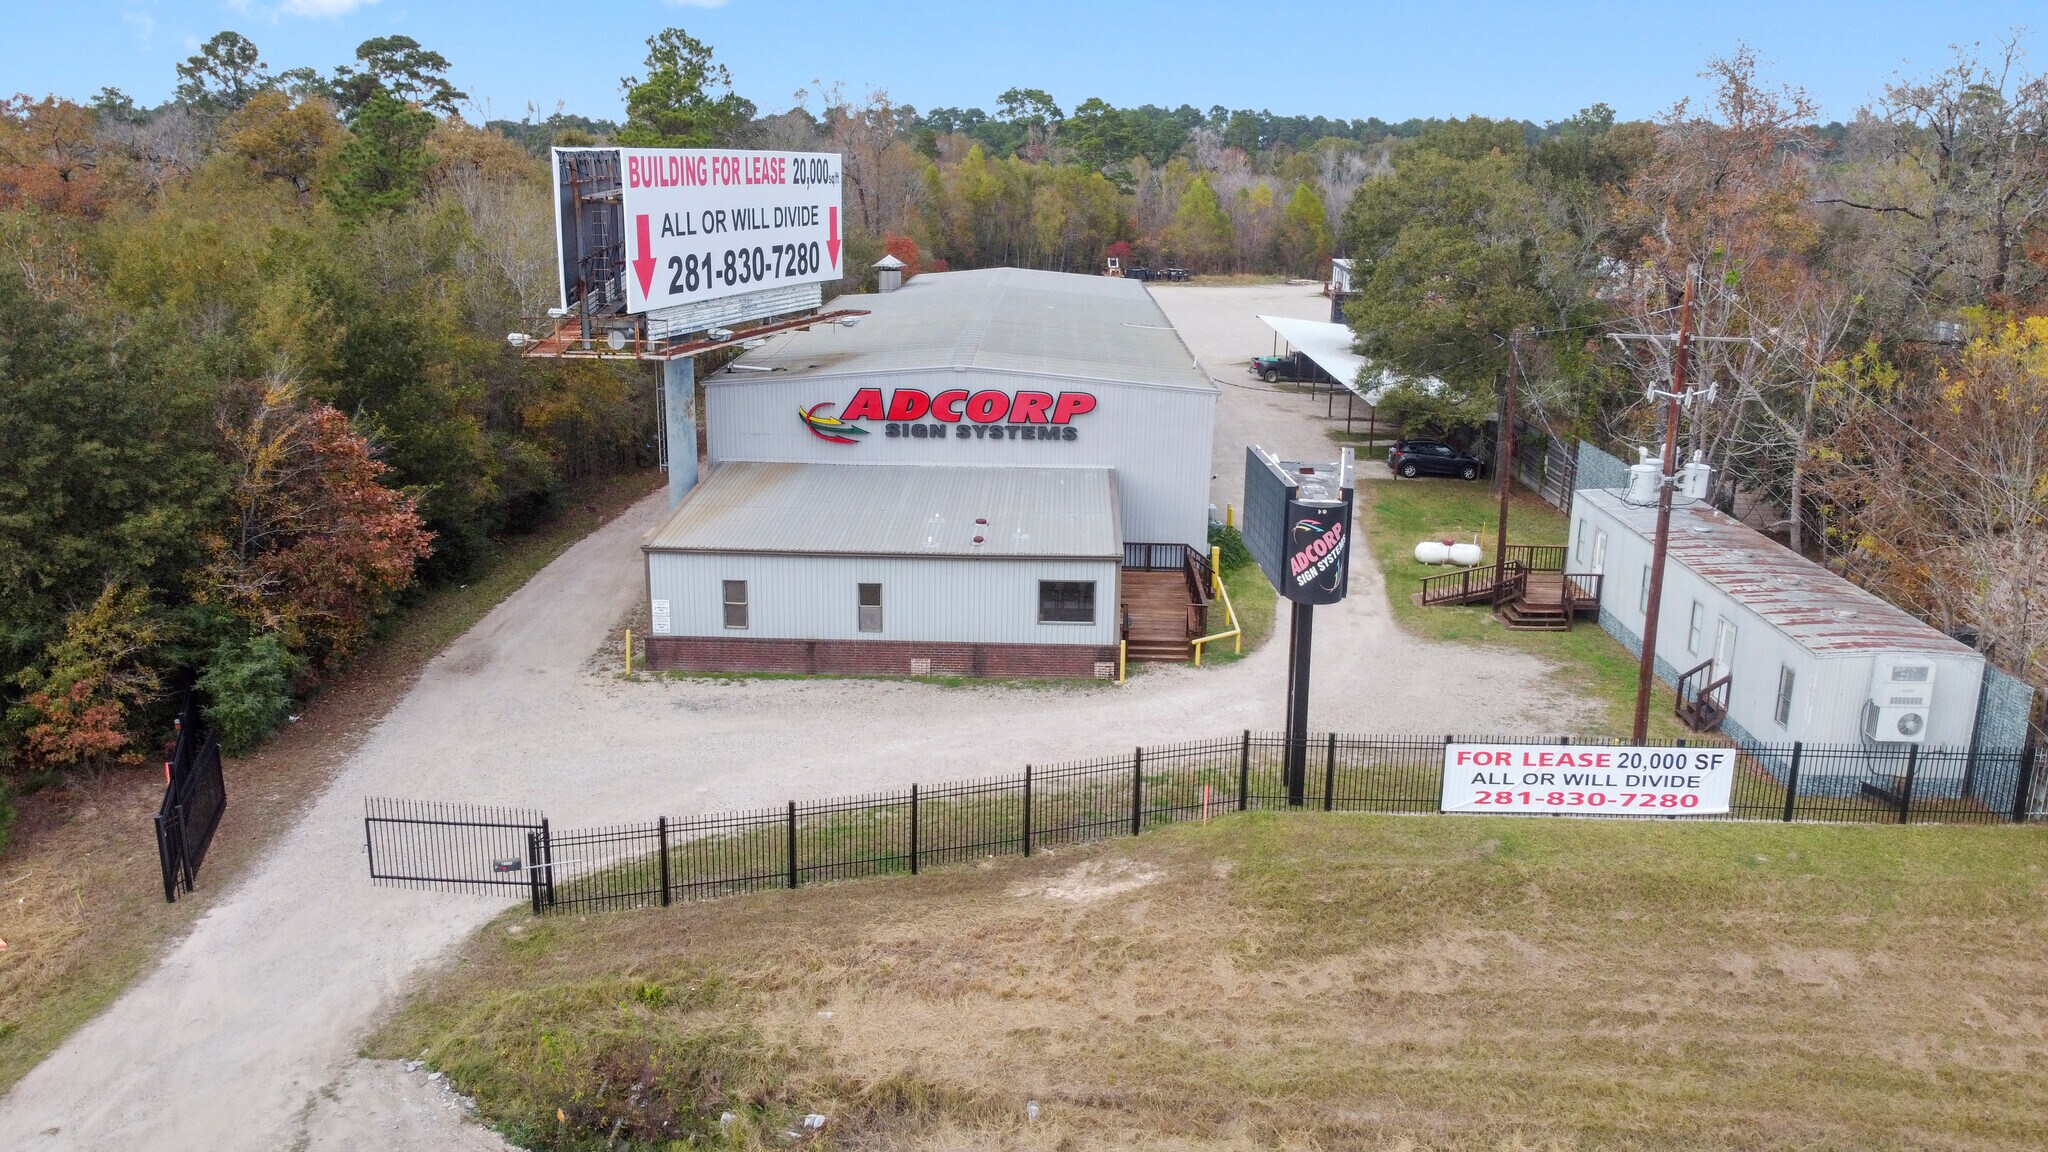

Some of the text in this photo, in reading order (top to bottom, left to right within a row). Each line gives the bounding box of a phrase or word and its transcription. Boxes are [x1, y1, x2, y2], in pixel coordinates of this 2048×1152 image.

[629, 155, 707, 188] BUILDING
[712, 156, 740, 186] FOR
[745, 156, 786, 185] LEASE
[661, 205, 819, 238] ALL OR WILL DIVIDE
[668, 241, 820, 295] 281-830-7280
[840, 388, 1097, 424] ADCORP
[885, 423, 1078, 441] SIGN SYSTEMS
[1290, 522, 1342, 577] ADCORP
[1297, 533, 1346, 586] SIGN SYSTEMS
[1457, 751, 1724, 771] FOR LEASE 20,000 SF
[1471, 772, 1700, 788] ALL OR WILL DIVIDE
[1474, 791, 1699, 808] 281-830-7280
